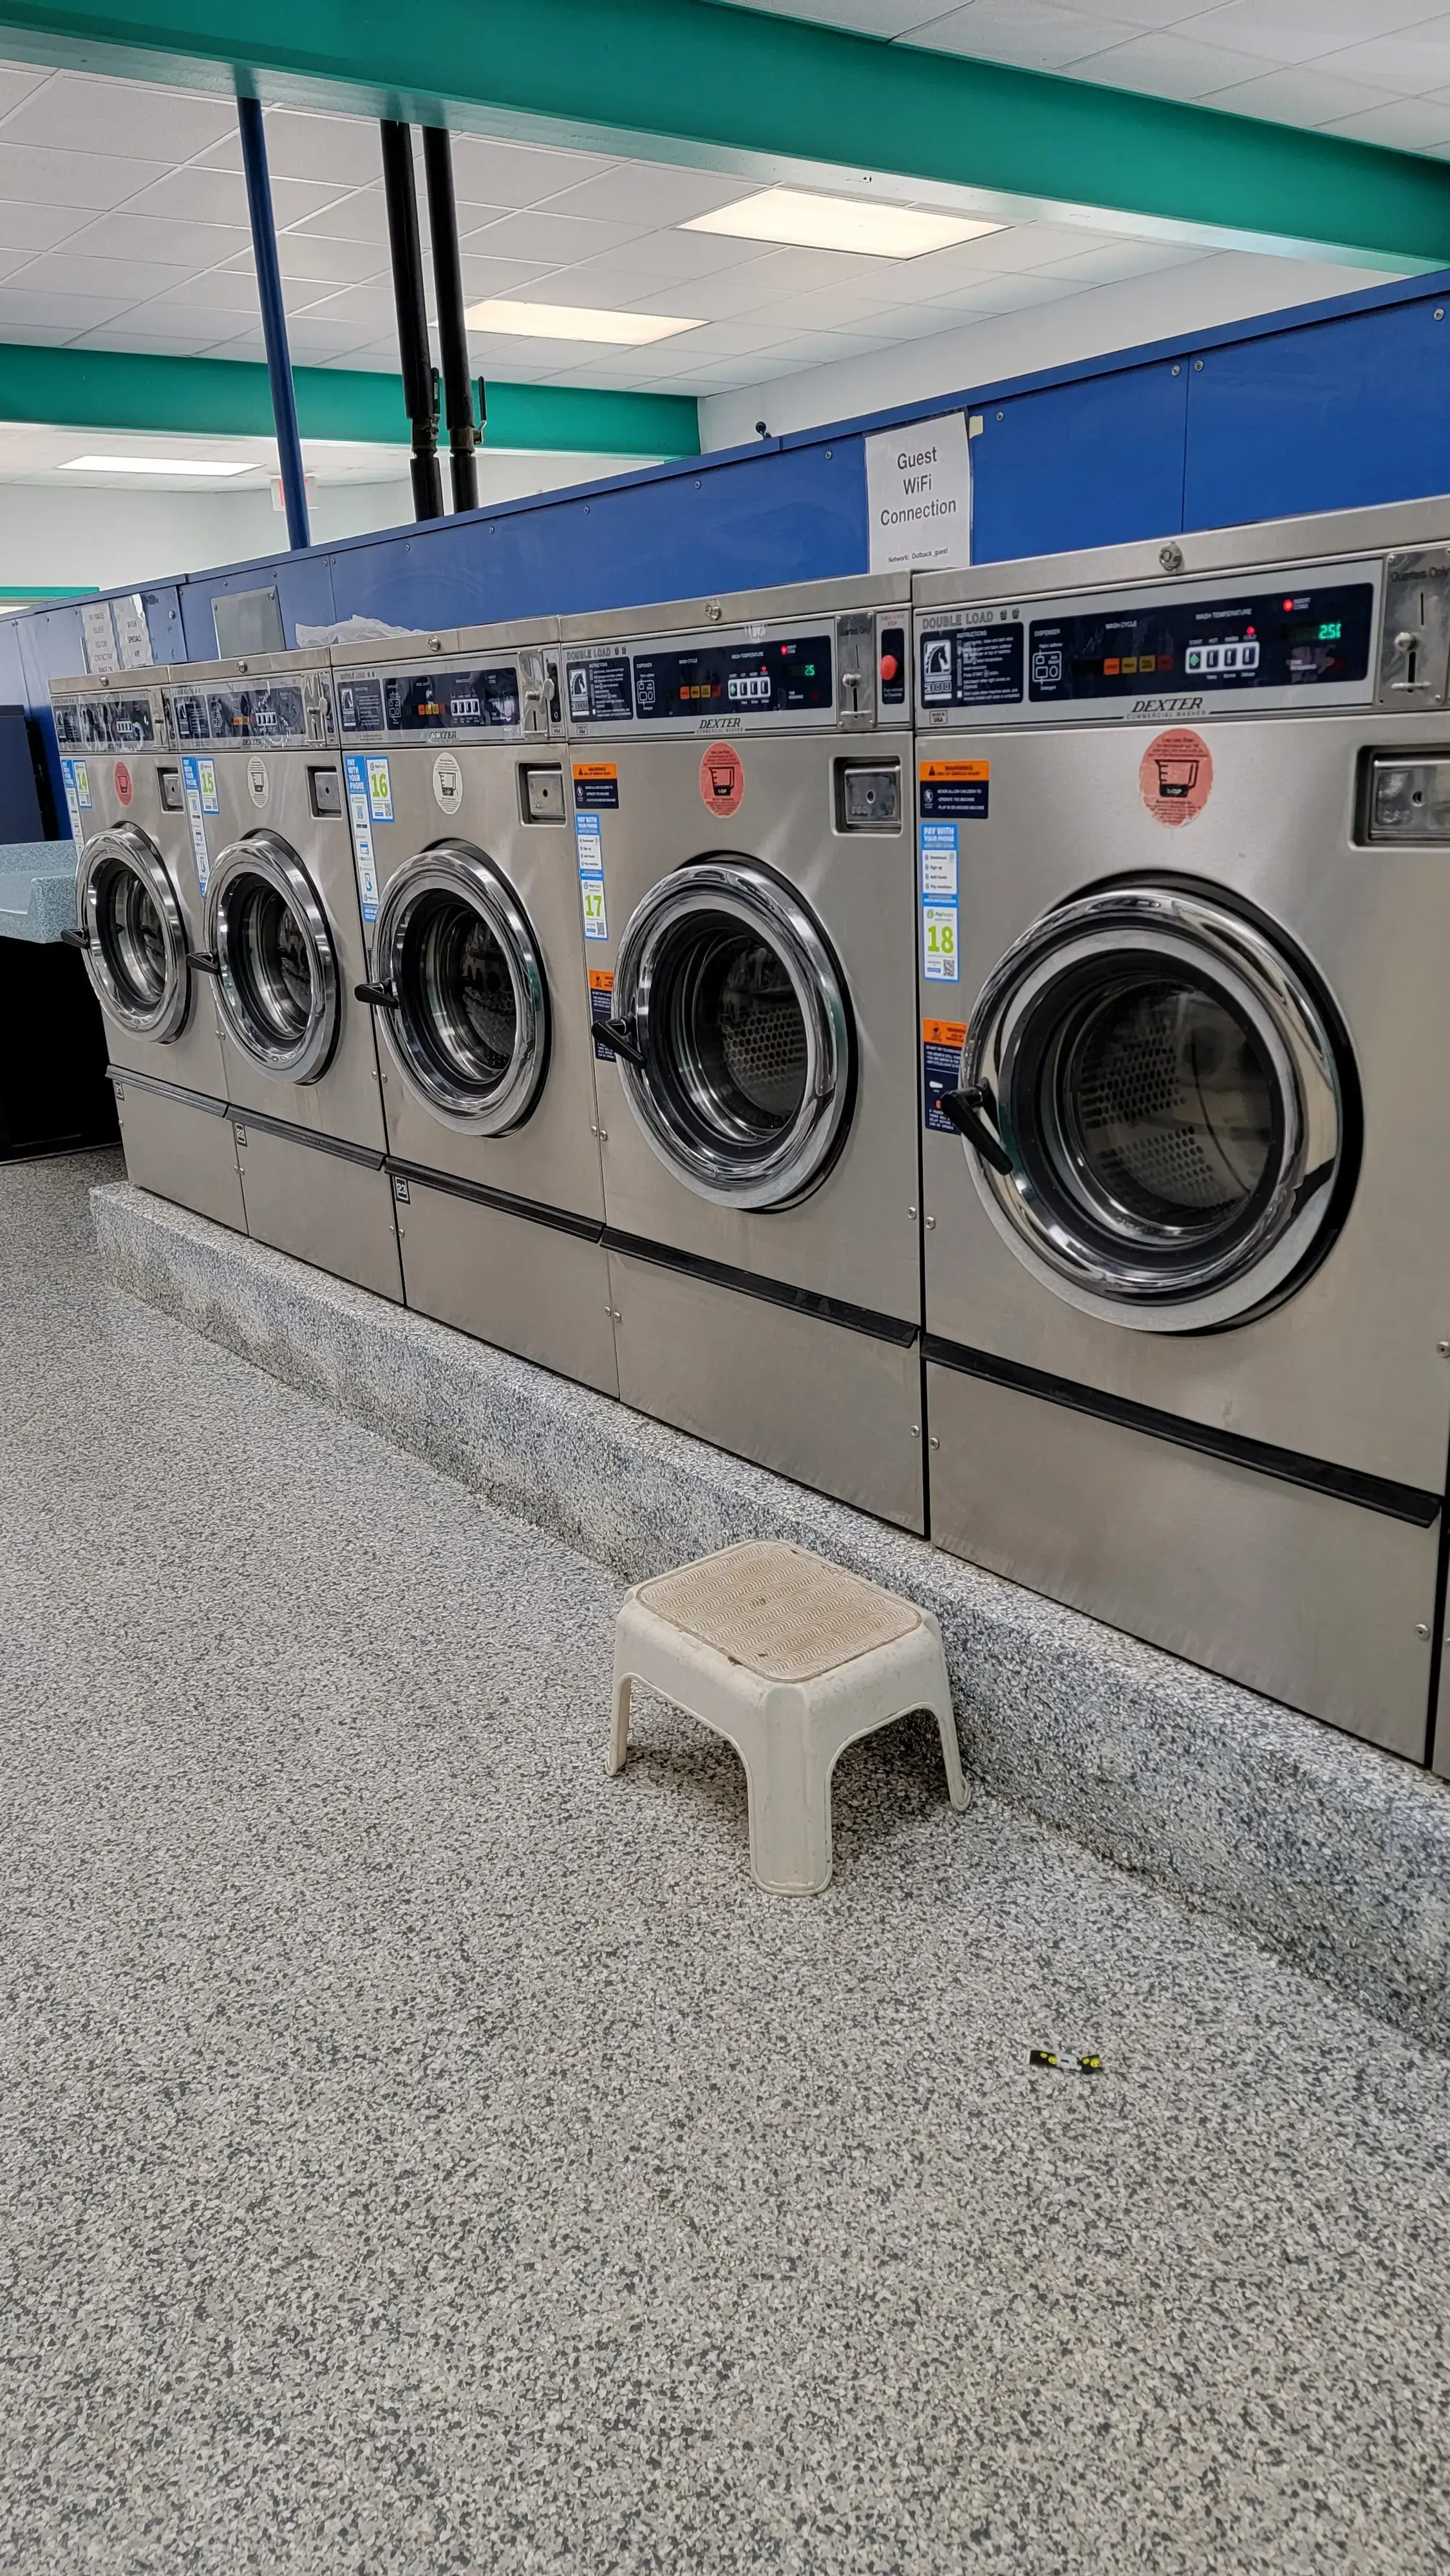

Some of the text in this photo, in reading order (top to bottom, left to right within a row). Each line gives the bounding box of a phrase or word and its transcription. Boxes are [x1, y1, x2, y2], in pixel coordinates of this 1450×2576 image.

[897, 446, 937, 470] Guest
[903, 473, 932, 495] WiFi
[880, 498, 957, 526] Connection
[888, 554, 909, 564] Network:
[923, 611, 993, 629] DOUBLE LOAD
[567, 647, 611, 661] DOUBLE LOAD
[925, 681, 952, 693] 300
[1132, 697, 1203, 713] DEXTER
[1127, 709, 1207, 719] COMMERCIAL WASHER
[699, 717, 740, 729] DEXTER
[429, 731, 457, 740] DEXTER
[202, 773, 214, 793] 15
[350, 782, 364, 790] PHONE
[372, 773, 388, 797] 16
[924, 827, 936, 835] PAY
[585, 895, 602, 917] 17
[928, 925, 954, 954] 18
